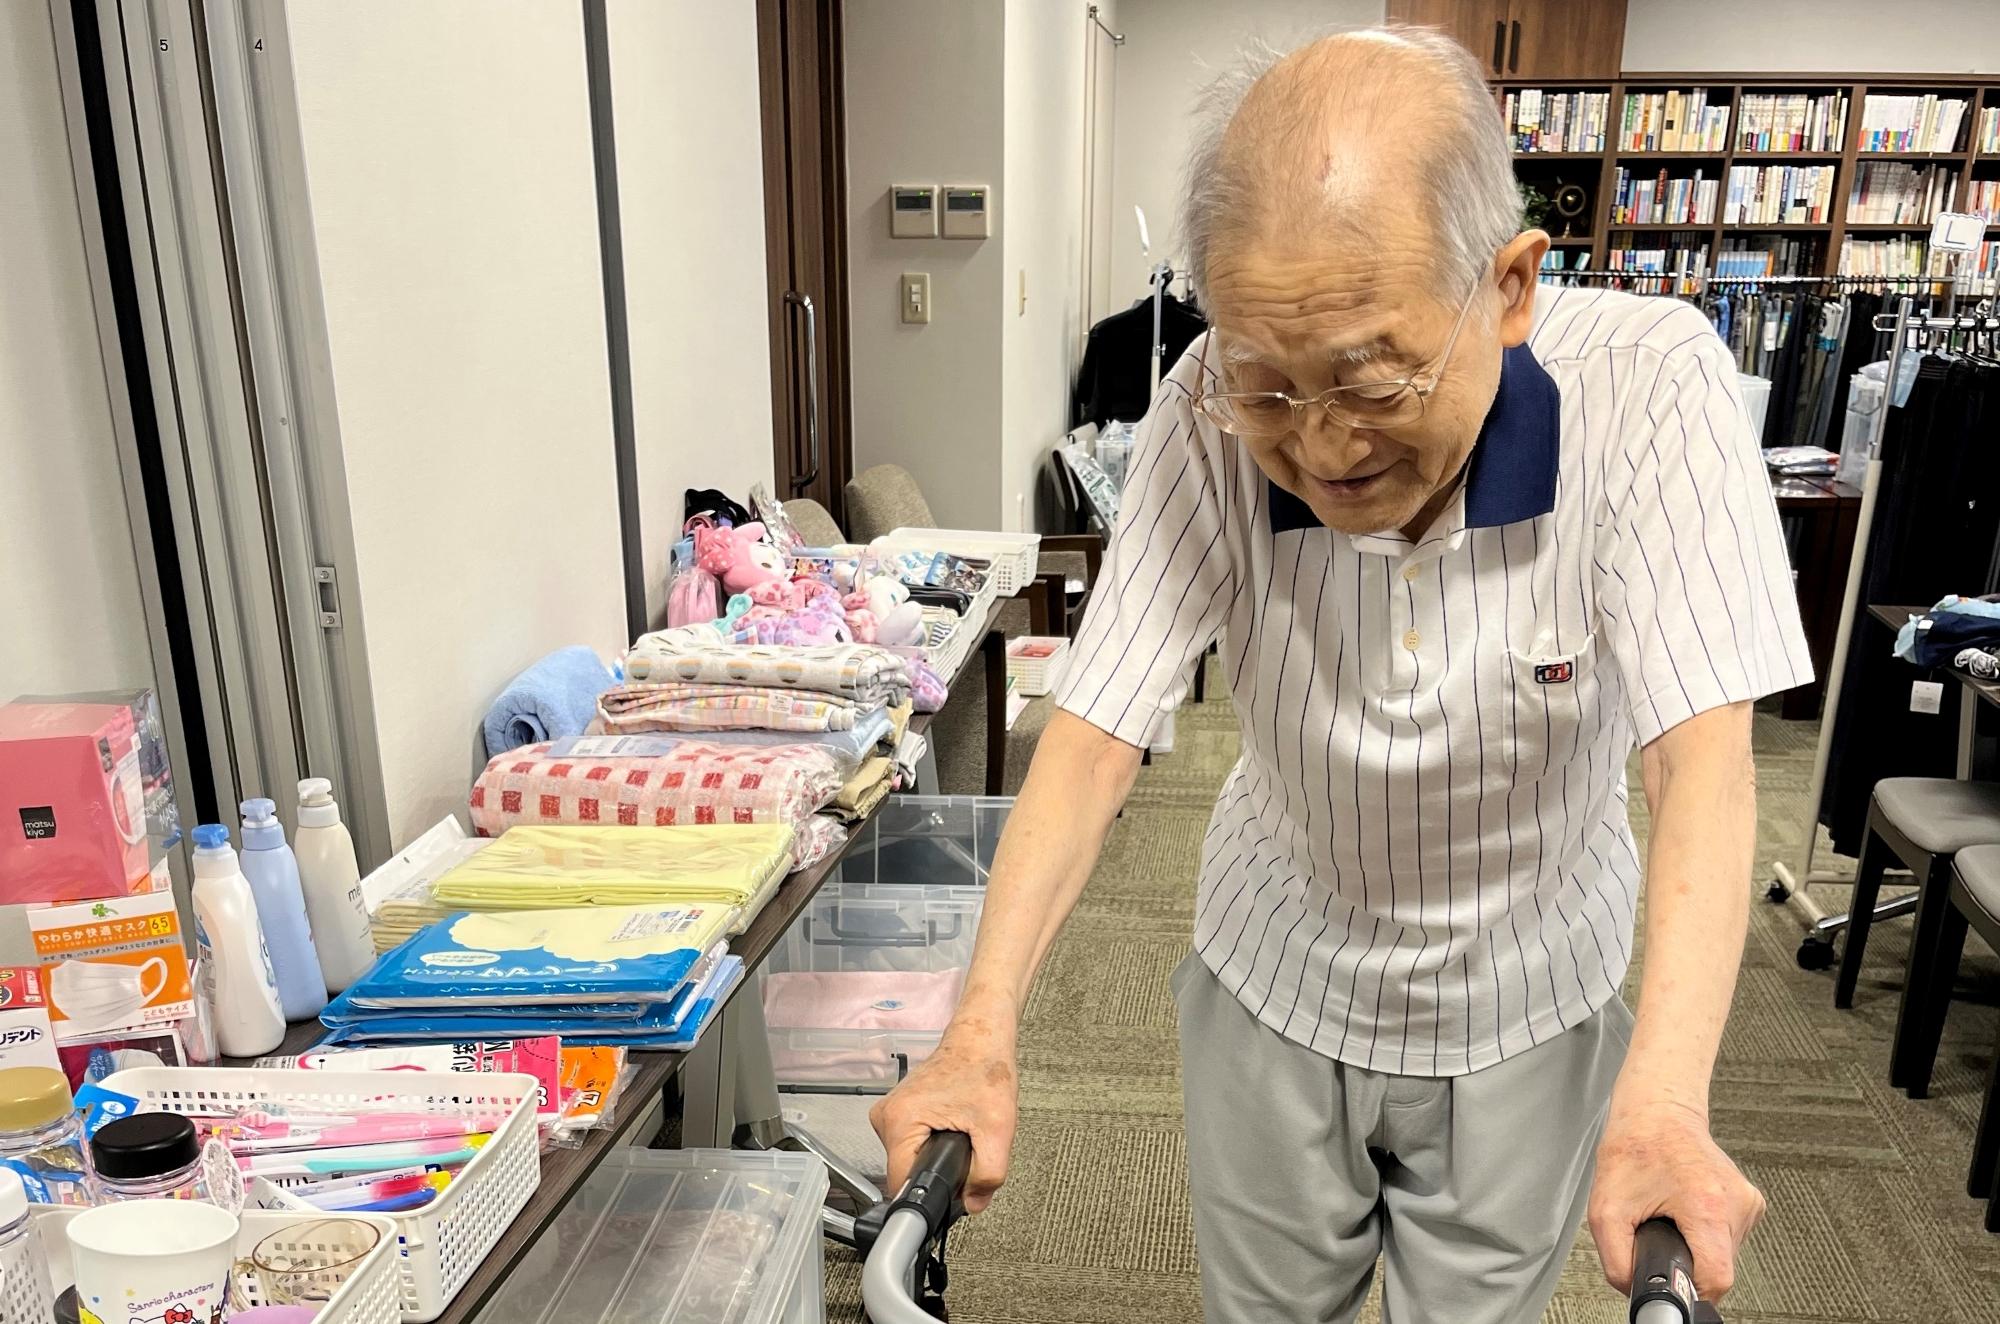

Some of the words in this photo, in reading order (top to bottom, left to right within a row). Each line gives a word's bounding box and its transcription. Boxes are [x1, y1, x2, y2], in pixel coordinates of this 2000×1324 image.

[159, 39, 169, 52] 5
[254, 38, 264, 51] 4
[1945, 220, 1967, 245] L
[25, 821, 55, 829] matsu
[26, 829, 45, 839] kiyo
[151, 916, 169, 931] 65
[38, 919, 147, 944] やわらか快適マスク
[127, 1298, 163, 1314] Sanrio
